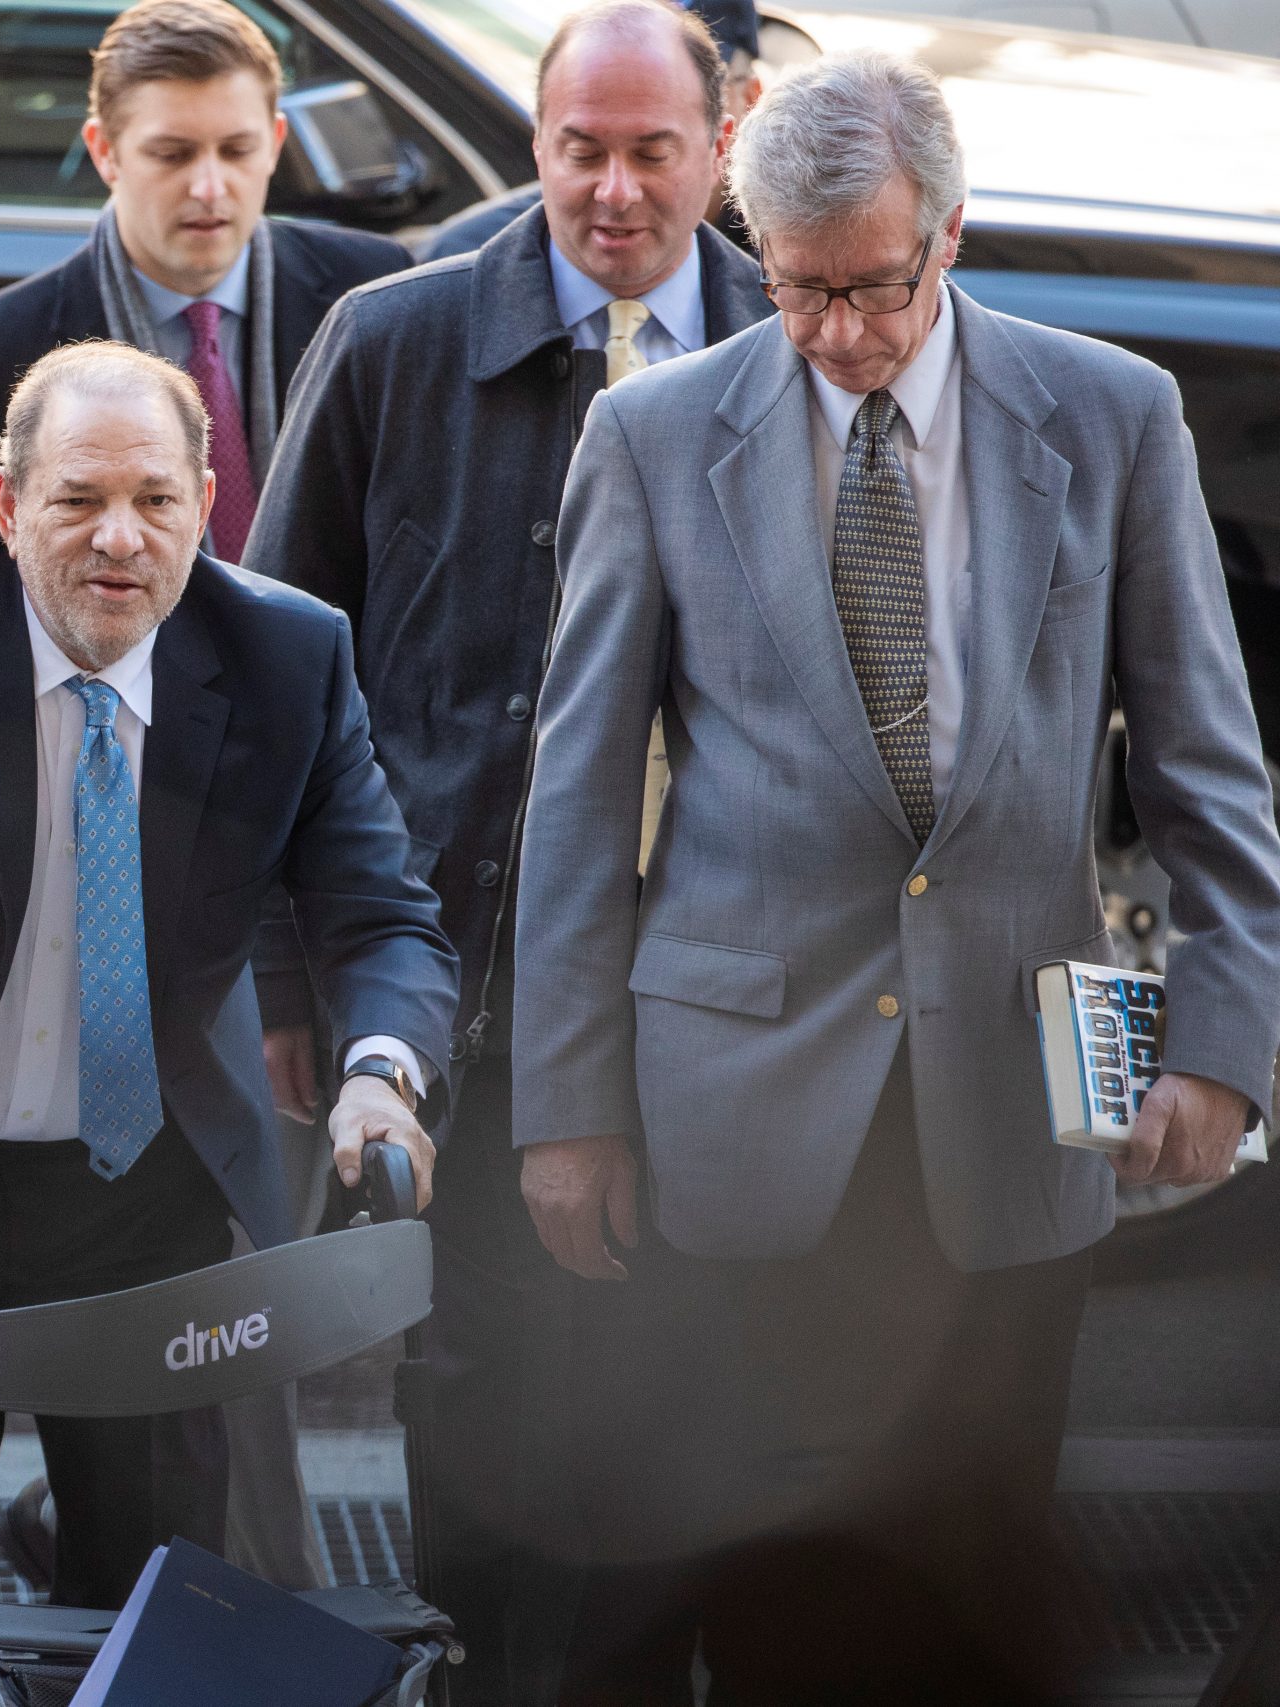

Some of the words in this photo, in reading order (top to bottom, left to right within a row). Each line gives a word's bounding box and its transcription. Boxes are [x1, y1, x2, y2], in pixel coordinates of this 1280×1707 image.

[1075, 974, 1129, 1126] Honor
[1116, 976, 1166, 1116] Secr
[1123, 1074, 1131, 1094] Novel
[164, 1313, 269, 1371] drive
